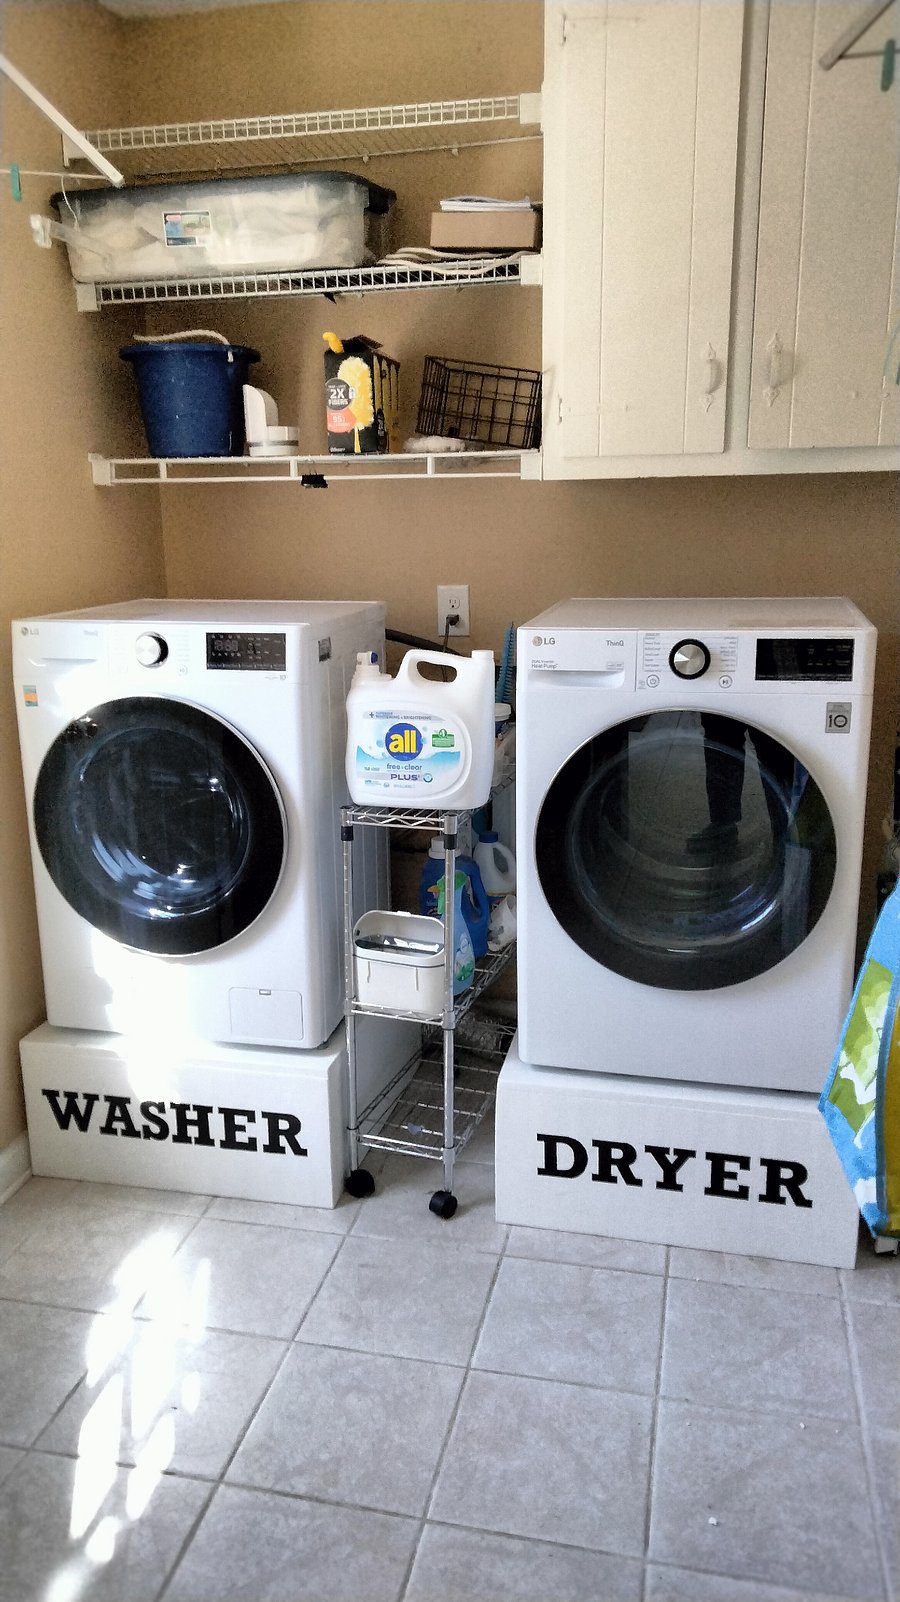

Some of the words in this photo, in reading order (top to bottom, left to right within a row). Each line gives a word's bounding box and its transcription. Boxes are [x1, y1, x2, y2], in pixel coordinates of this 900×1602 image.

[330, 388, 345, 399] 2X
[543, 637, 556, 645] LG
[606, 639, 625, 647] ThinQ
[828, 714, 848, 728] 10
[388, 730, 417, 753] all
[386, 762, 401, 770] free
[404, 763, 422, 771] clear
[42, 1088, 308, 1157] WASHER
[537, 1133, 813, 1208] DRYER
